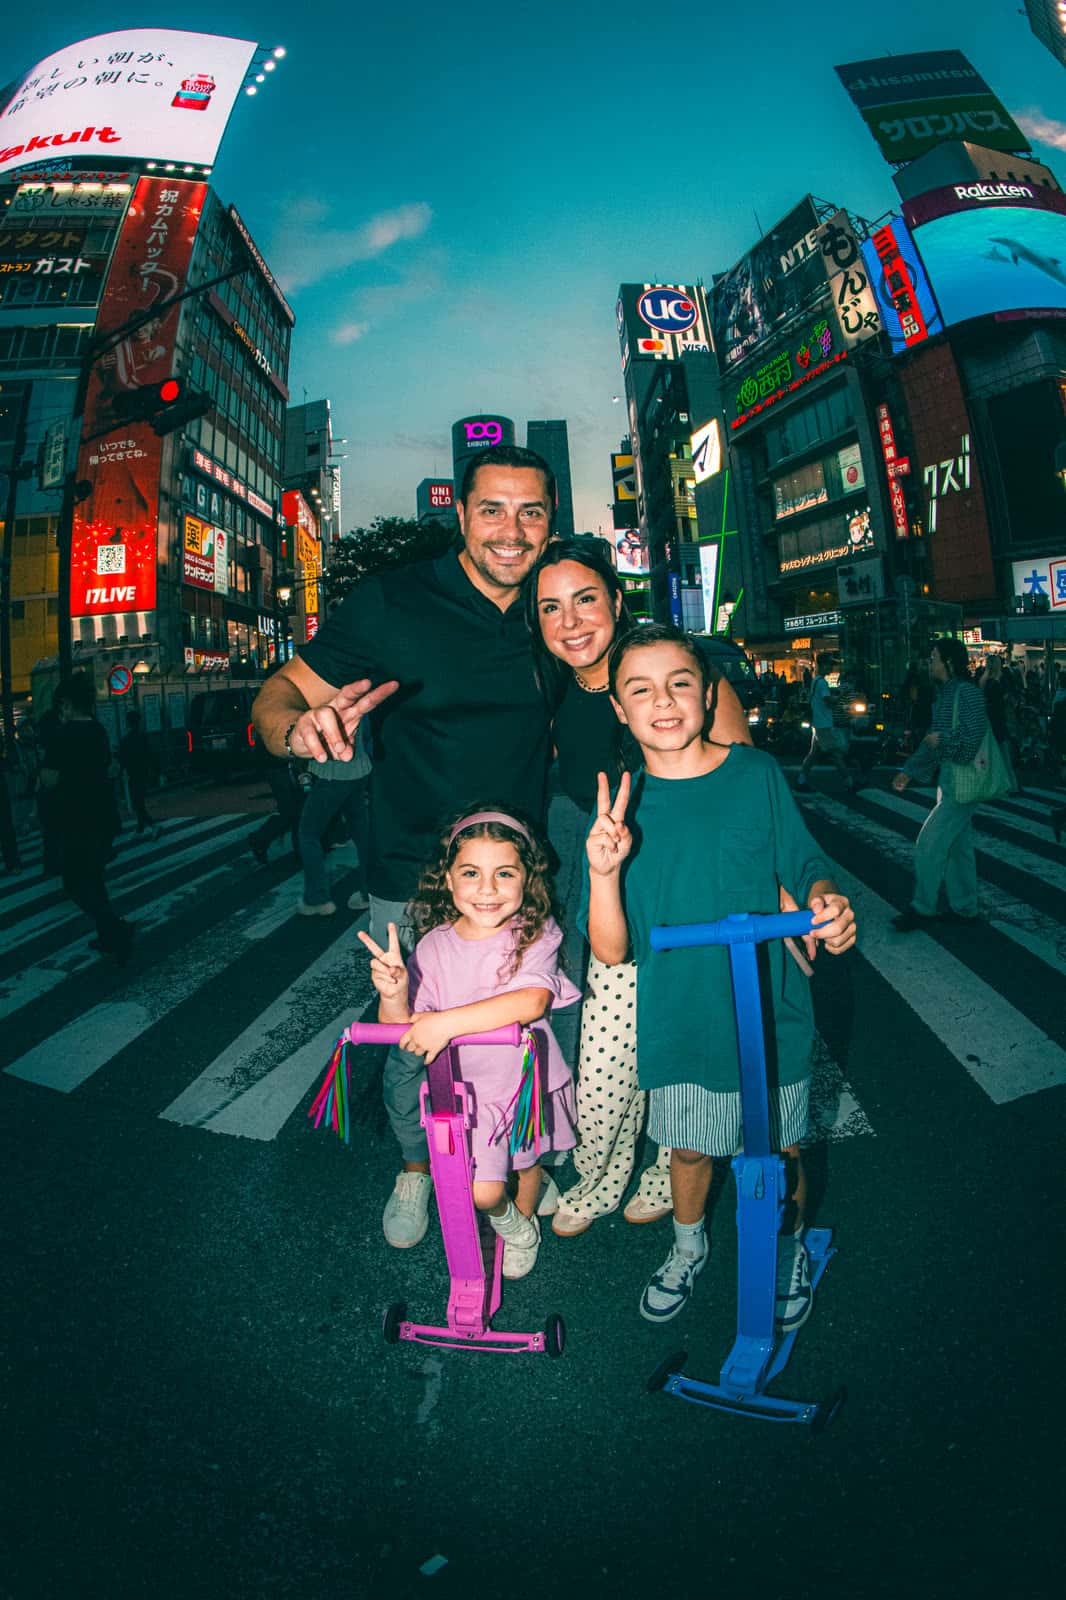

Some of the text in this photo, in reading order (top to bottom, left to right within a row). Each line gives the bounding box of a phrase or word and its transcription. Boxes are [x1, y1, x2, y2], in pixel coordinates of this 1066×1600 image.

[878, 109, 1010, 141] サロンパス
[51, 191, 123, 209] しゃぶ葉
[954, 183, 1033, 200] Rakuten
[780, 228, 818, 275] NTE
[33, 256, 92, 275] ガスト
[683, 343, 710, 352] VISA
[759, 360, 792, 397] 西村
[463, 421, 503, 446] 109
[99, 439, 137, 452] いつでも
[432, 487, 449, 496] UNI
[432, 496, 451, 505] QLO
[184, 562, 215, 585] サンドラッグ
[85, 585, 137, 605] 17LIVE
